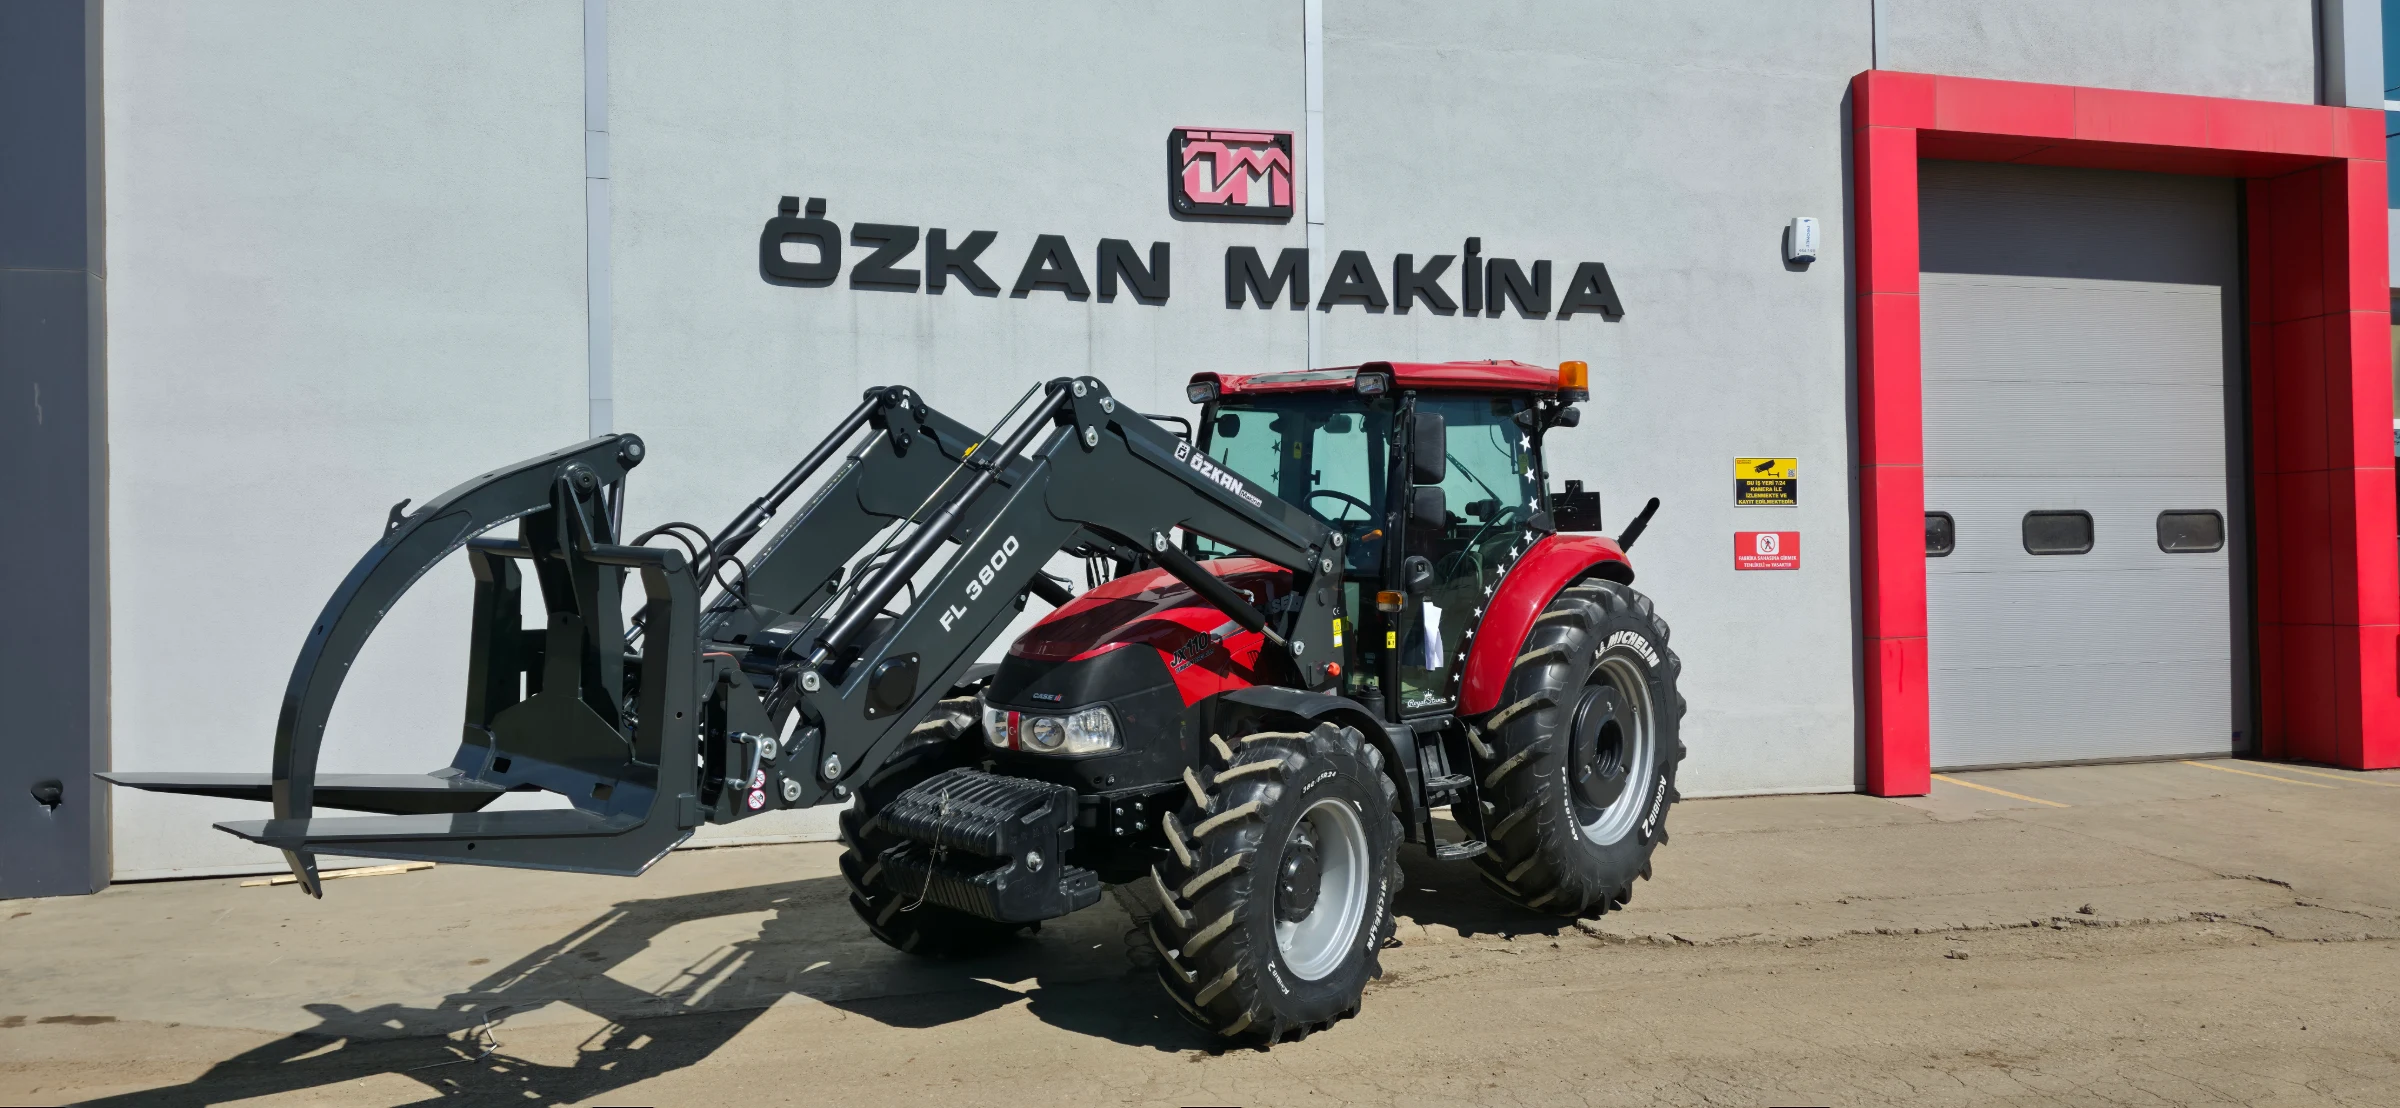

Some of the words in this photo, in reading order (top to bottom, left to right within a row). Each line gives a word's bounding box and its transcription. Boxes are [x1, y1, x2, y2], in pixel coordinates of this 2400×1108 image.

[759, 195, 1172, 304] ÖZKAN
[1225, 236, 1626, 322] MAKİNA
[1190, 452, 1244, 496] ÖZKAN
[1755, 479, 1761, 487] İŞ
[938, 604, 968, 632] FL
[965, 535, 1020, 601] 3800
[1606, 630, 1661, 668] MICHELIN
[1032, 692, 1055, 701] CASE
[1648, 774, 1667, 826] AGRIBIB
[1641, 818, 1653, 838] 2
